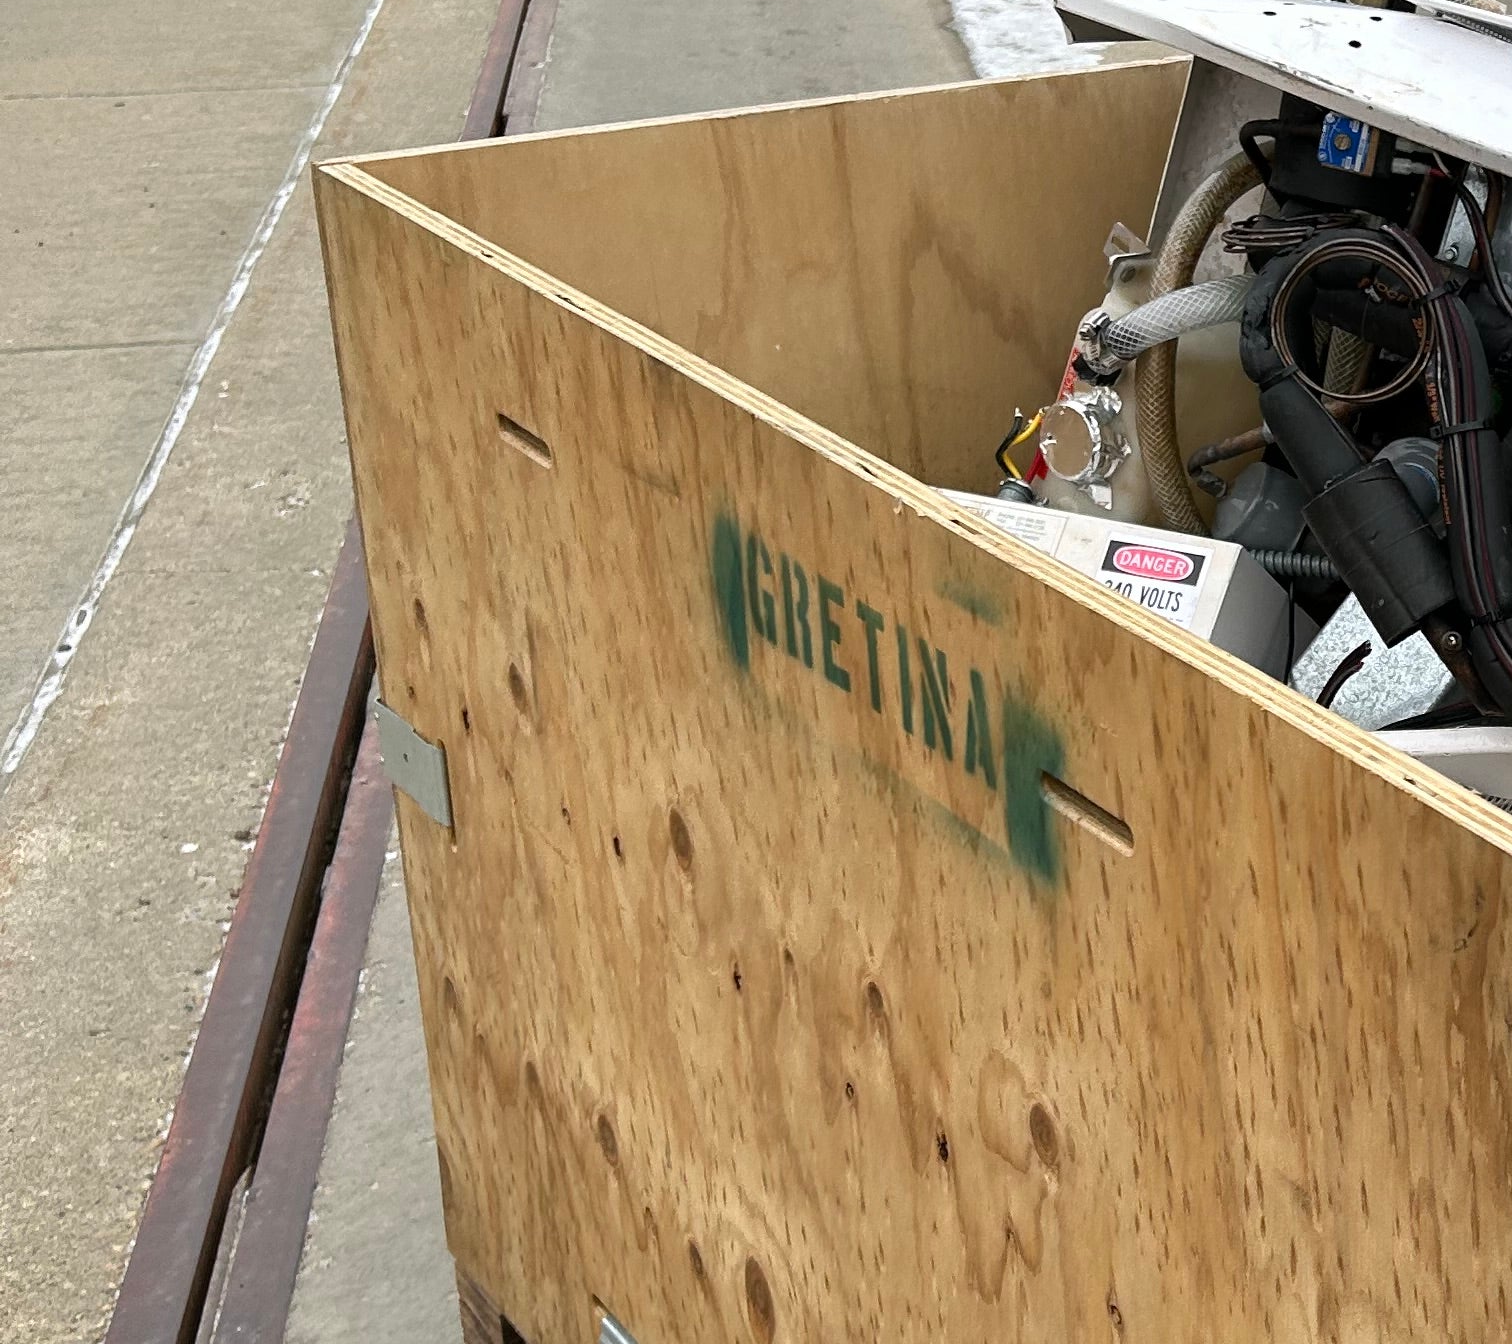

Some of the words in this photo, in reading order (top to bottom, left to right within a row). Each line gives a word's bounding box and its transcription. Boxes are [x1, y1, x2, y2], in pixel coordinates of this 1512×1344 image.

[1119, 551, 1187, 576] DANGER
[1139, 585, 1184, 613] VOLTS
[745, 533, 998, 792] GRETINA
